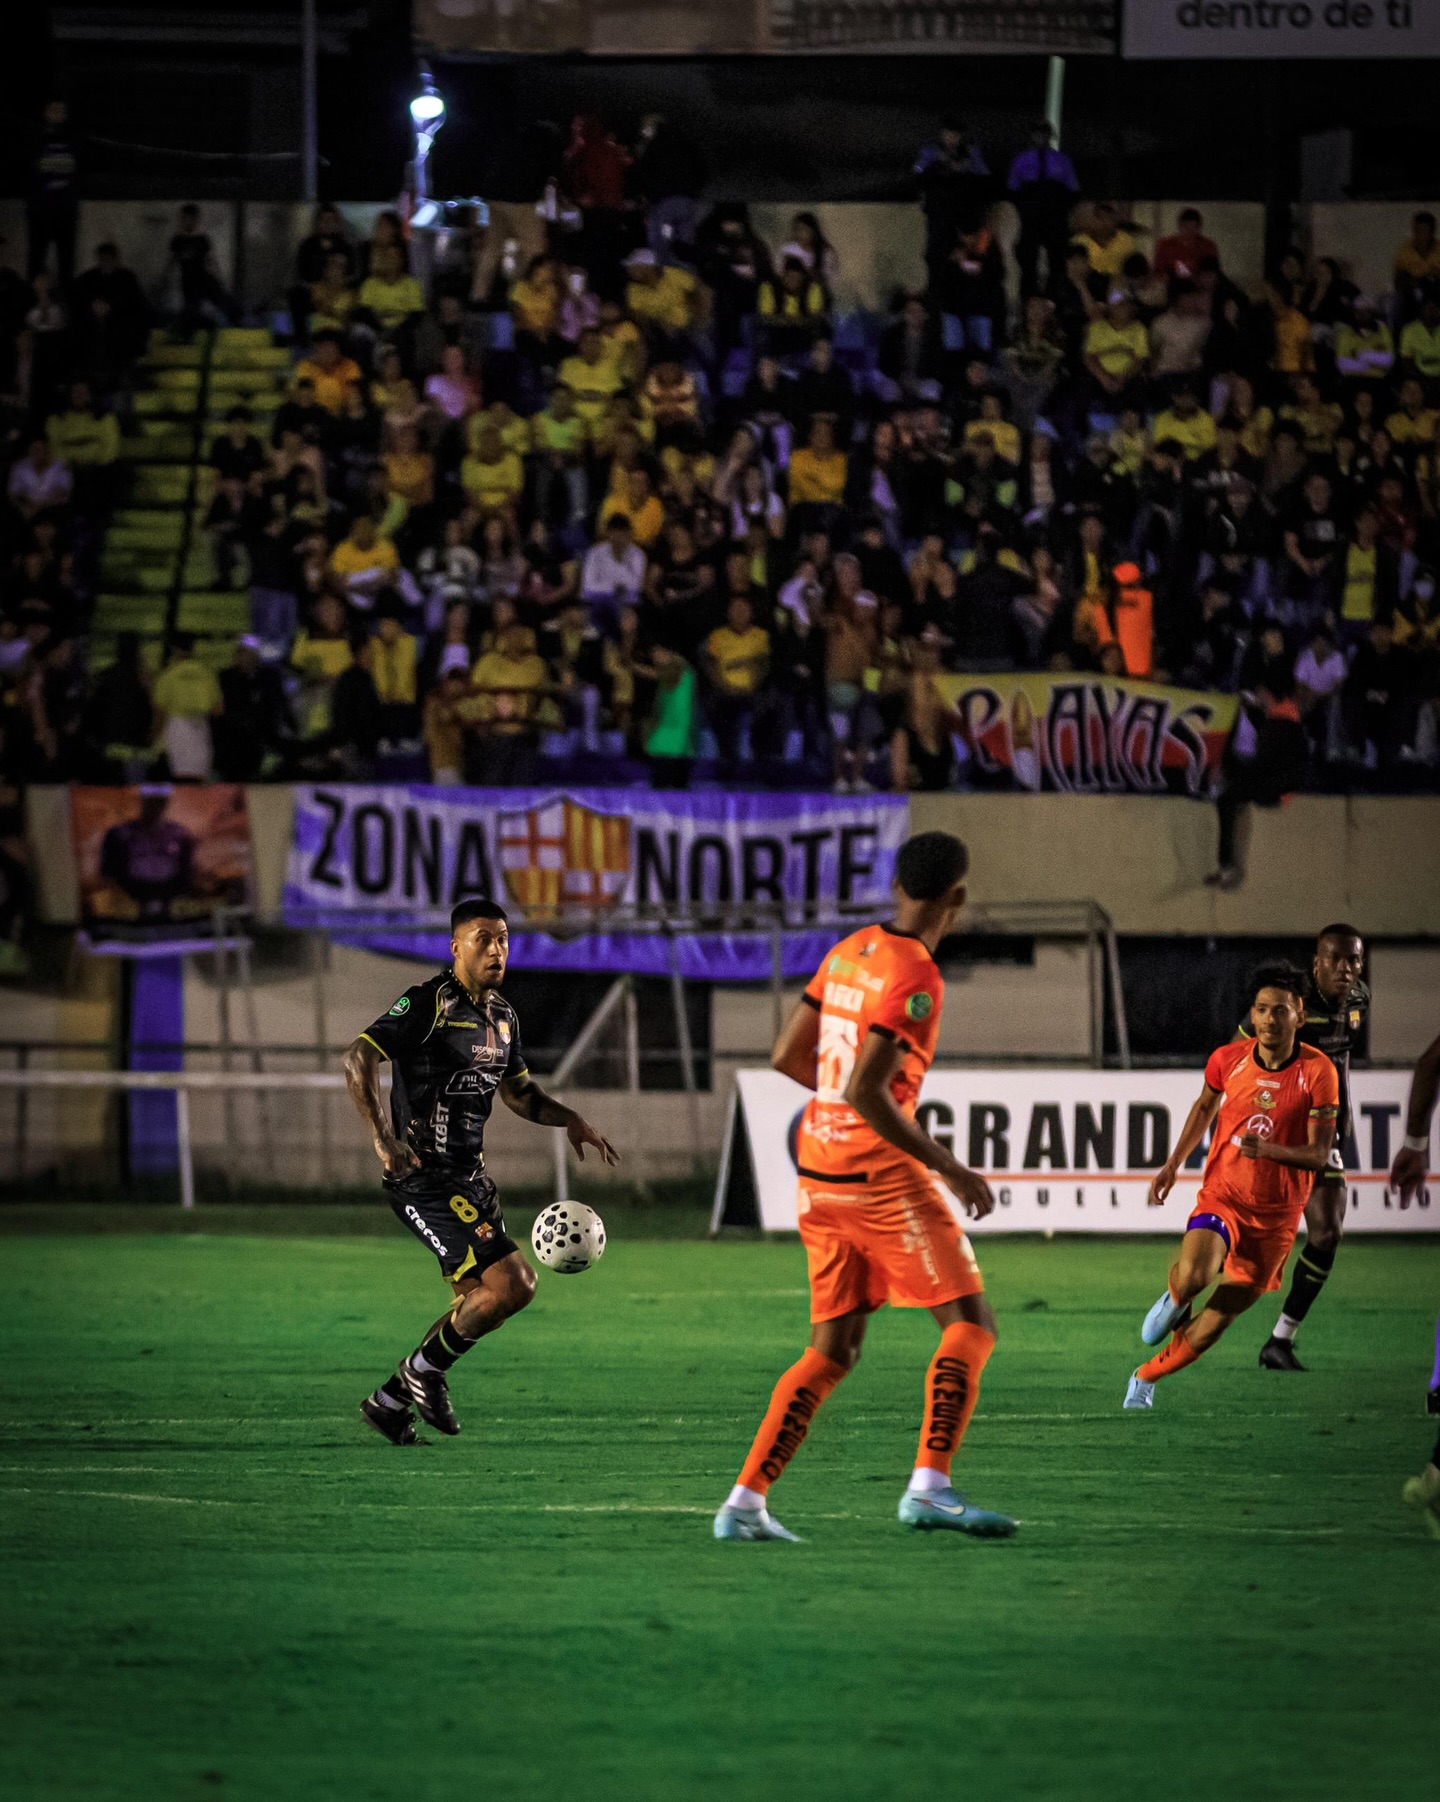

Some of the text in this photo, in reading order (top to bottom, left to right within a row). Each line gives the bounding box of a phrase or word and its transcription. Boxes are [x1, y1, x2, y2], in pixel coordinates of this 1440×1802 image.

[1177, 0, 1412, 29] dentro de ti
[956, 680, 1214, 793] PAYAS
[310, 791, 880, 928] ZONA NORTE
[916, 1100, 1171, 1170] GRAND
[405, 1204, 448, 1257] crecos
[449, 1195, 479, 1224] 8
